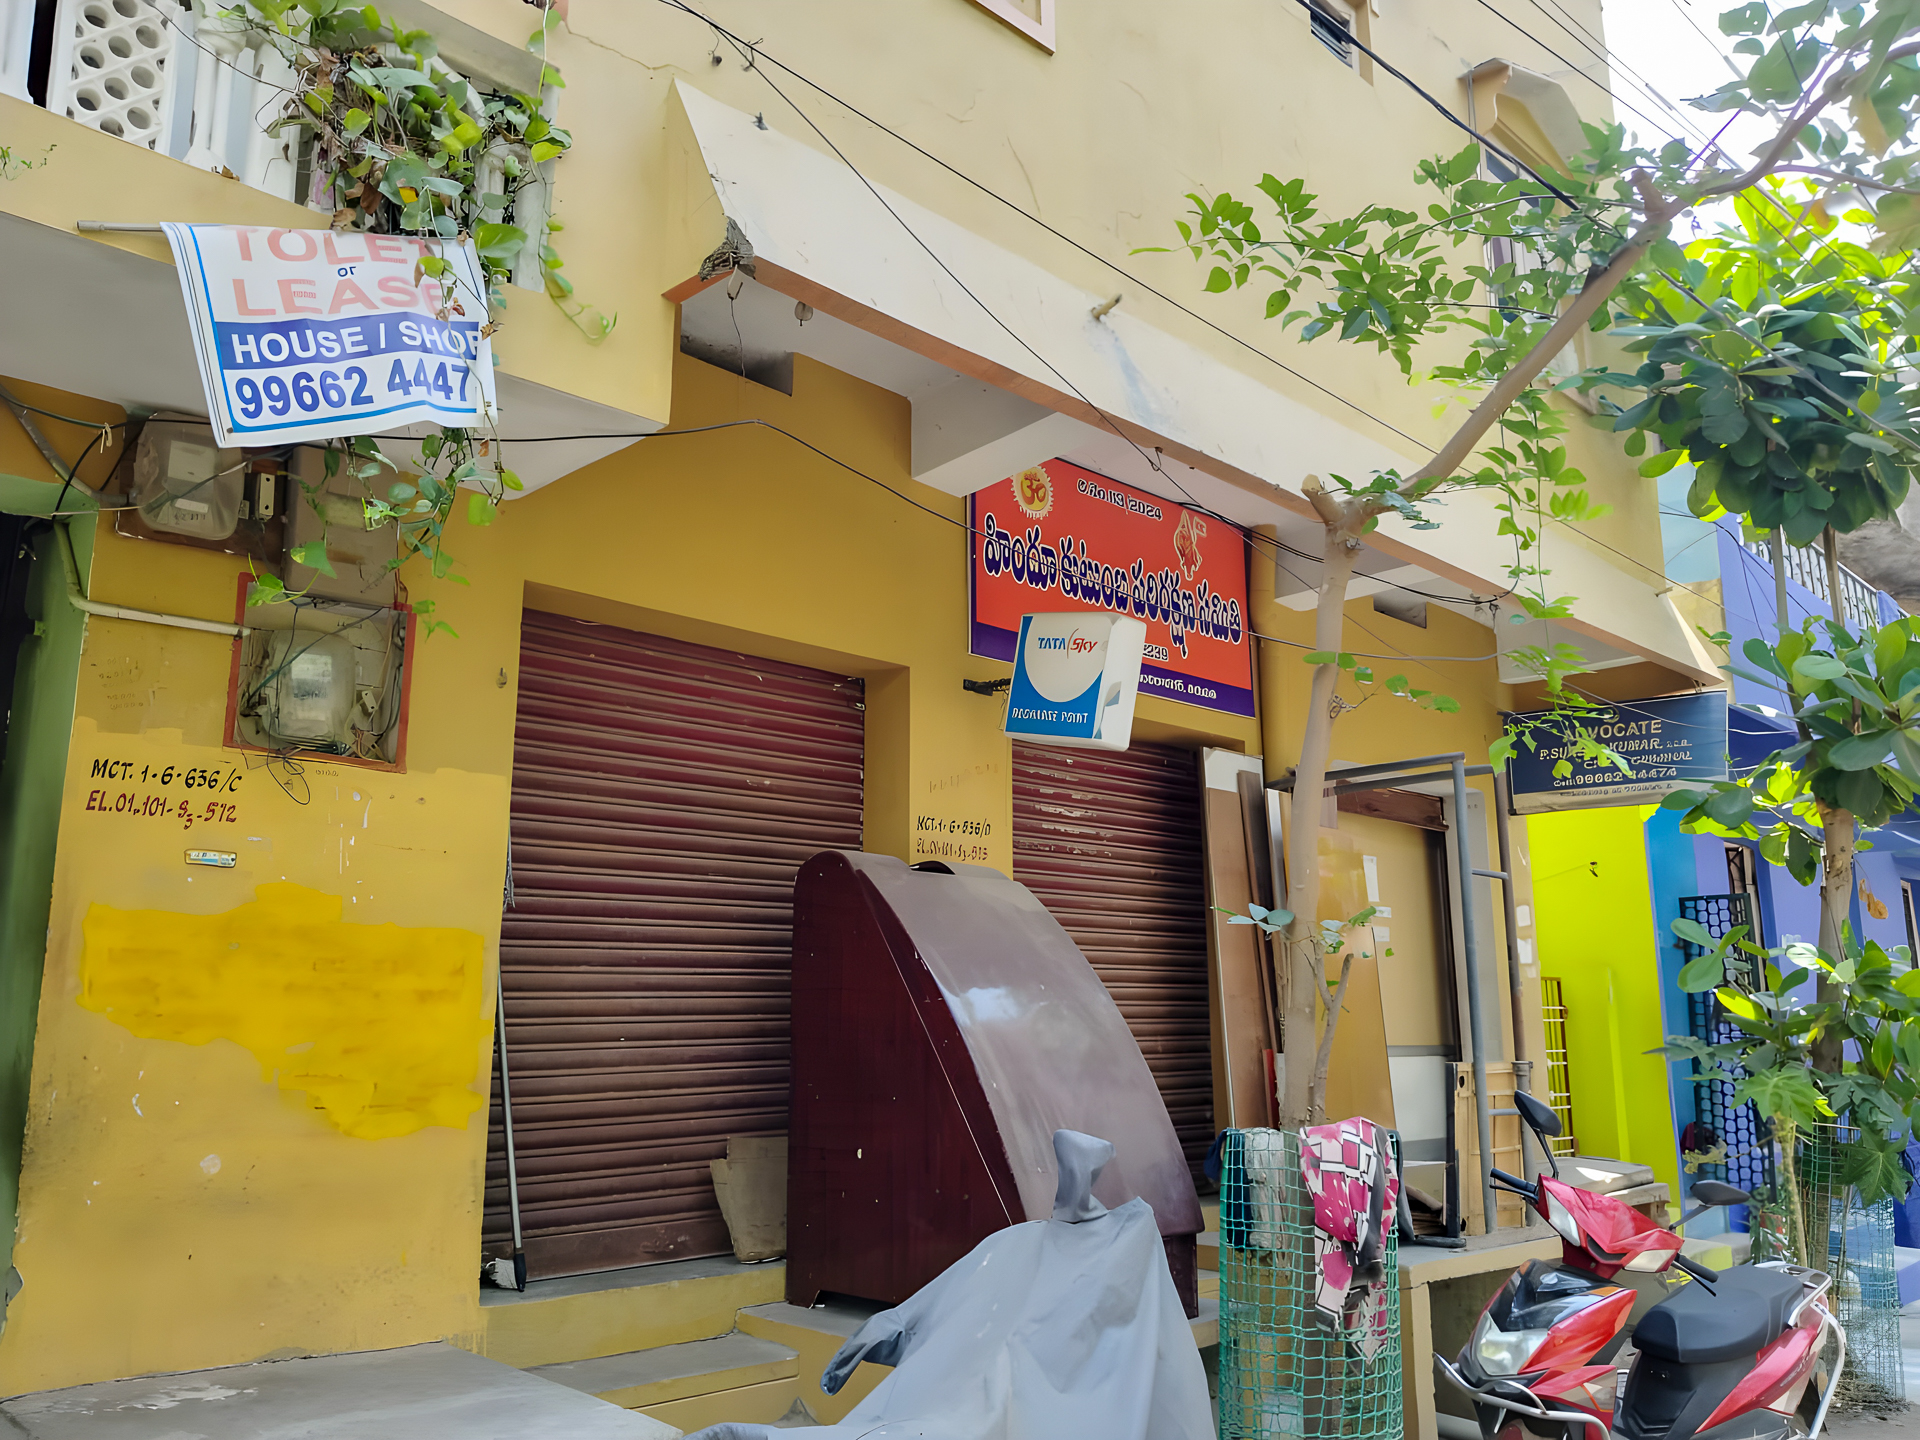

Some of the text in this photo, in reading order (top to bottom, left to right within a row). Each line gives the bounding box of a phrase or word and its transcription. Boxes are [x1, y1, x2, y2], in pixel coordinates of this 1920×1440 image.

[338, 266, 356, 277] or
[231, 325, 369, 364] HOUSE
[235, 358, 471, 419] 99662 4447
[1038, 637, 1066, 650] TATA
[1566, 718, 1662, 740] VOCATE
